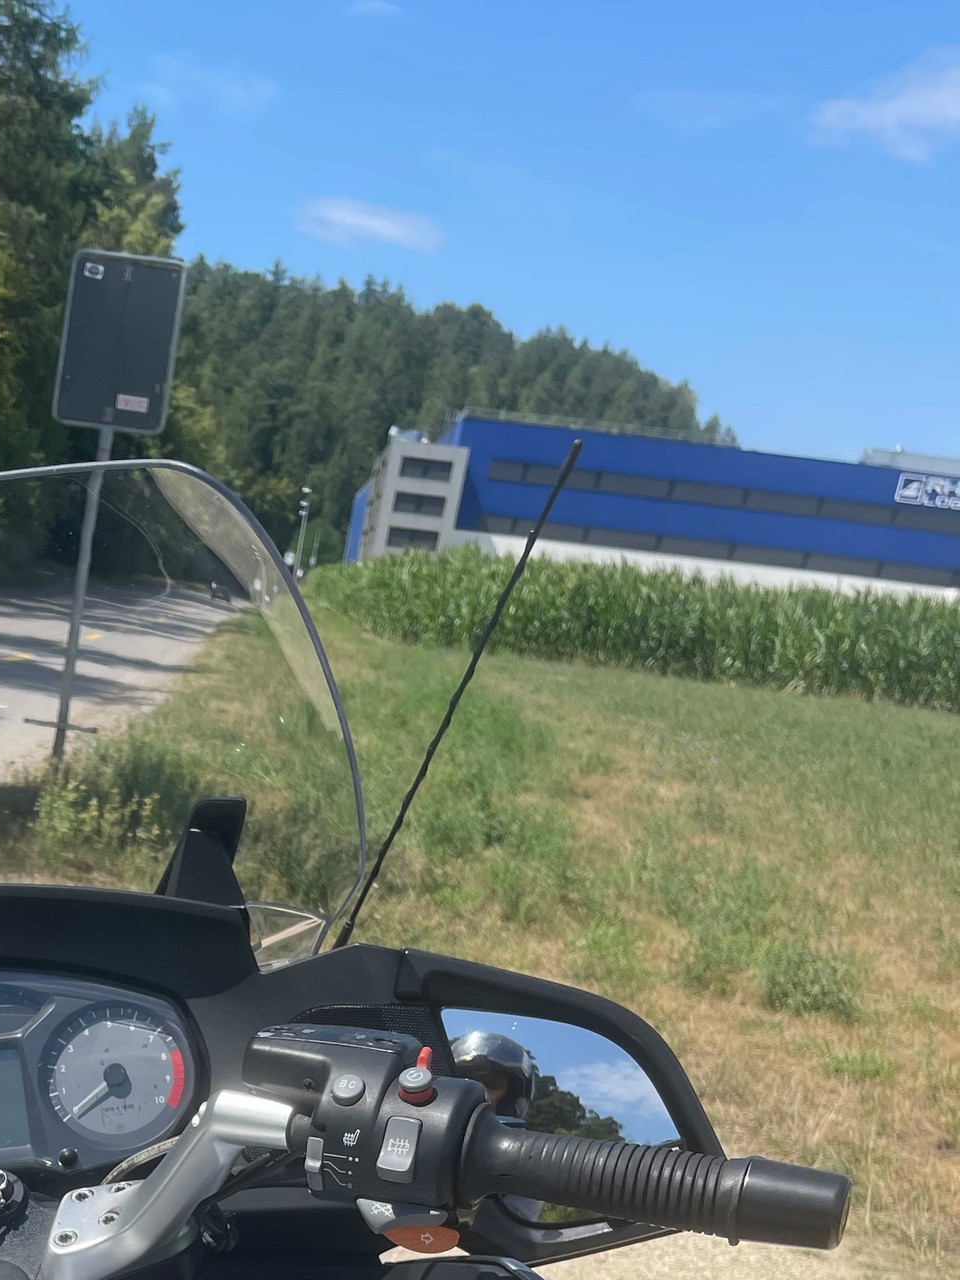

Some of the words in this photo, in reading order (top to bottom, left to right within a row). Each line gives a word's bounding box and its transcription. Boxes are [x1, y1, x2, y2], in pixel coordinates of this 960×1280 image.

[129, 1023, 136, 1031] 6
[83, 1028, 89, 1036] 4
[148, 1035, 154, 1043] 7
[68, 1045, 74, 1053] 3
[161, 1052, 167, 1060] 8
[60, 1065, 66, 1073] 2
[339, 1079, 357, 1089] BC
[155, 1096, 165, 1104] 10
